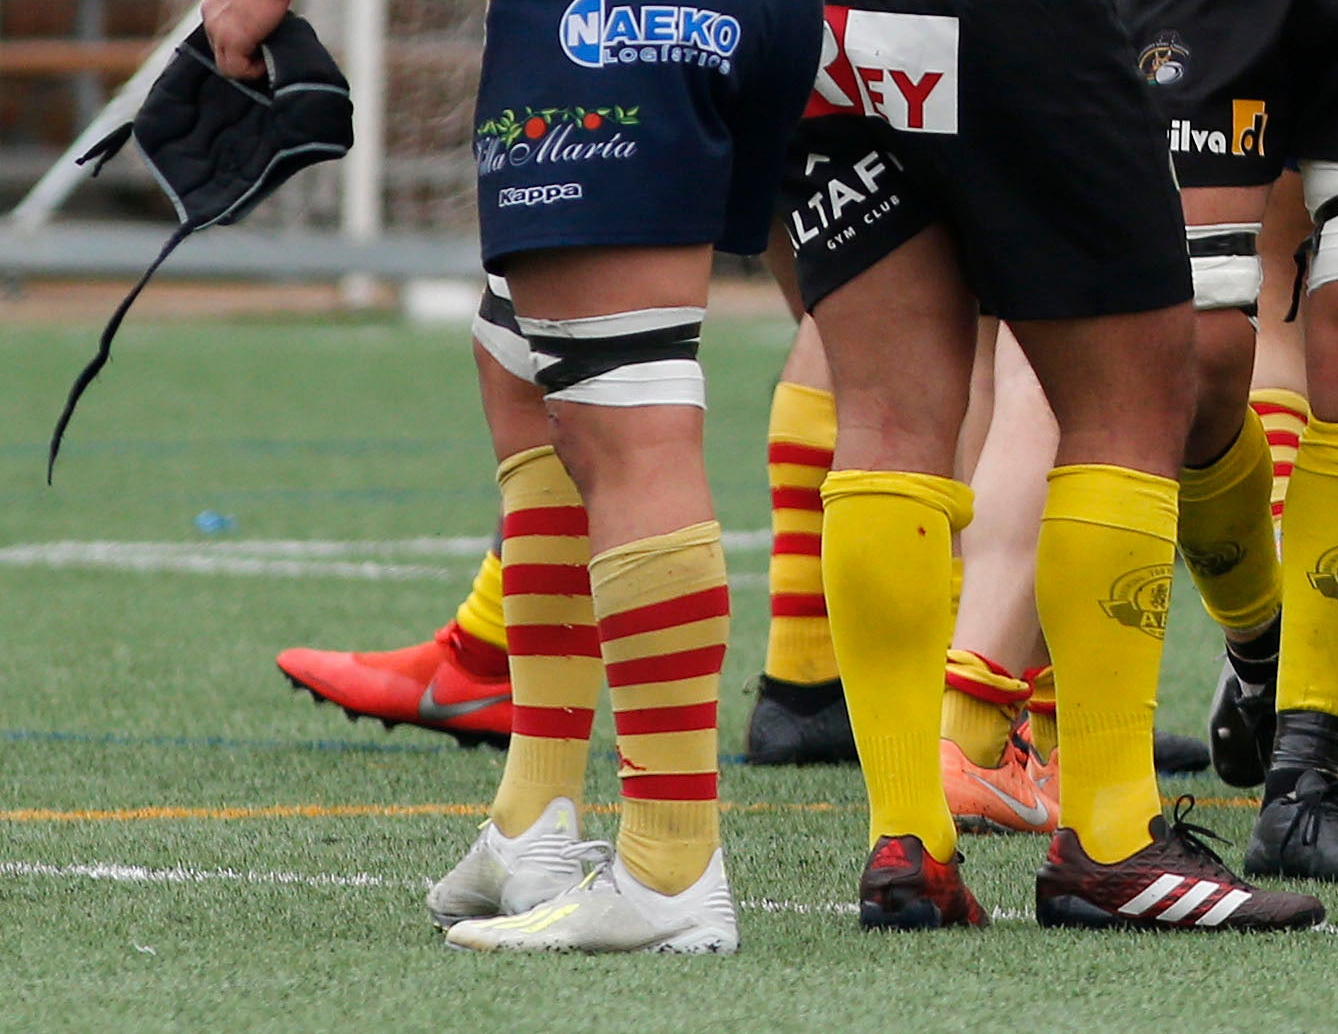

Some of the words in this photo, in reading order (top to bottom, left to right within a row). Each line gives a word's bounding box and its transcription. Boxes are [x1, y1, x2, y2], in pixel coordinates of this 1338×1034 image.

[566, 5, 742, 58] NAEKO
[509, 123, 638, 167] María
[1168, 119, 1227, 155] ilva
[499, 182, 583, 208] Kappa
[826, 225, 856, 250] GYM
[863, 195, 900, 224] CLUB
